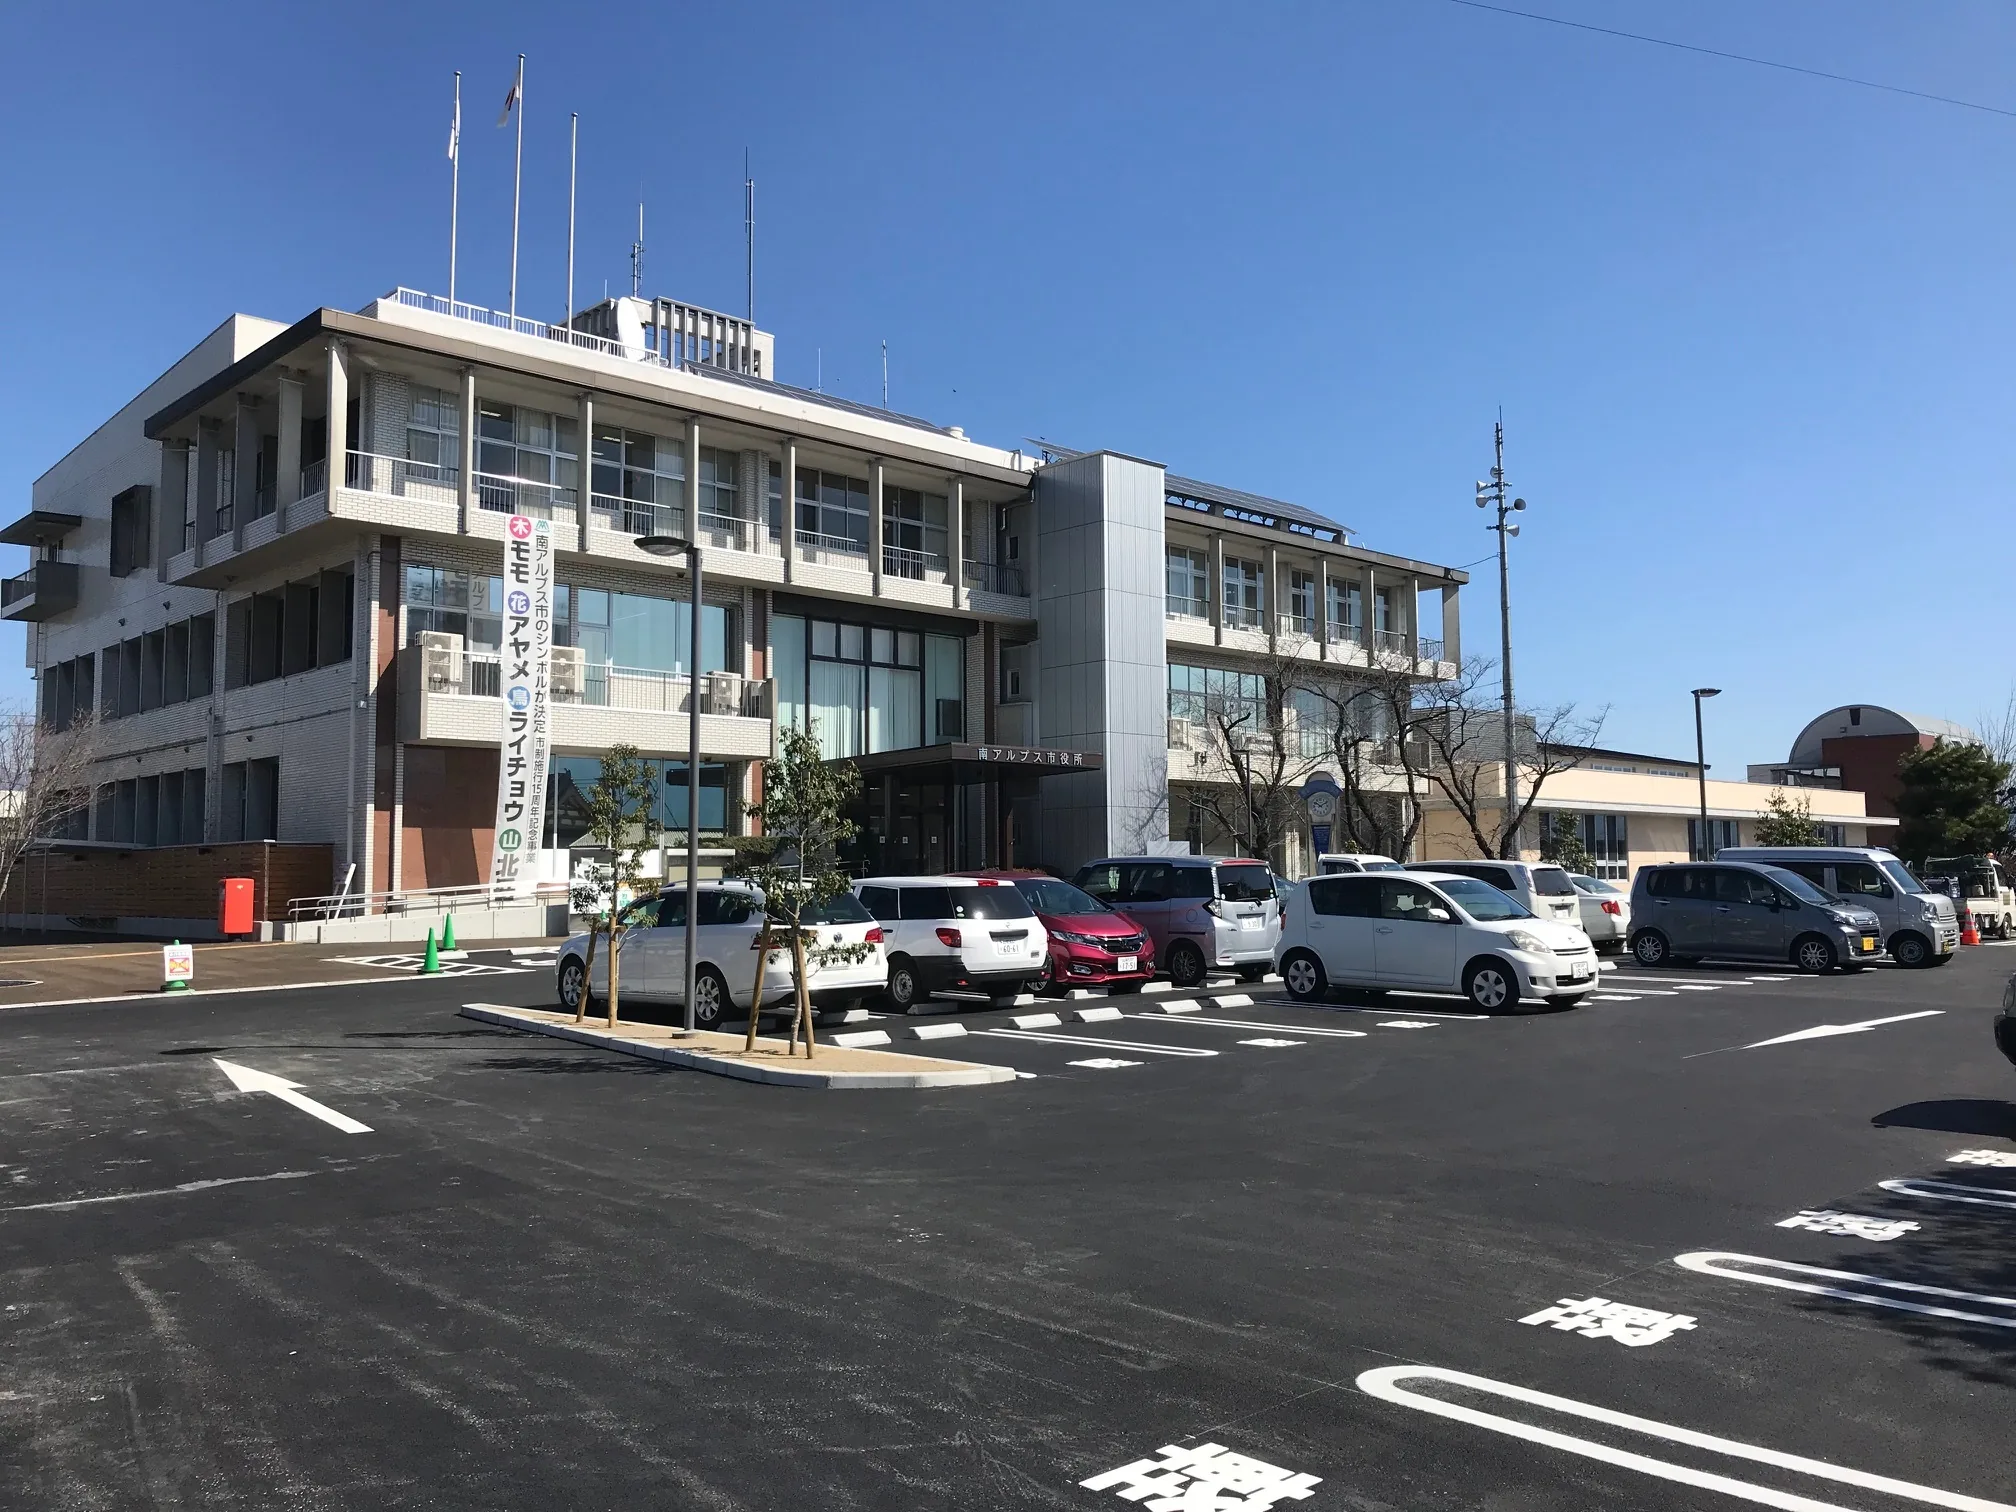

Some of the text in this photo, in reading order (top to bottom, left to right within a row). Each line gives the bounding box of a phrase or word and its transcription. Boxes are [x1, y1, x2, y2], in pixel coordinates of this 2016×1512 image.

[510, 540, 530, 584] モモ
[509, 616, 530, 680] アヤメ
[505, 711, 528, 822] ライチョウ
[978, 747, 1083, 766] 南アルプス市役所
